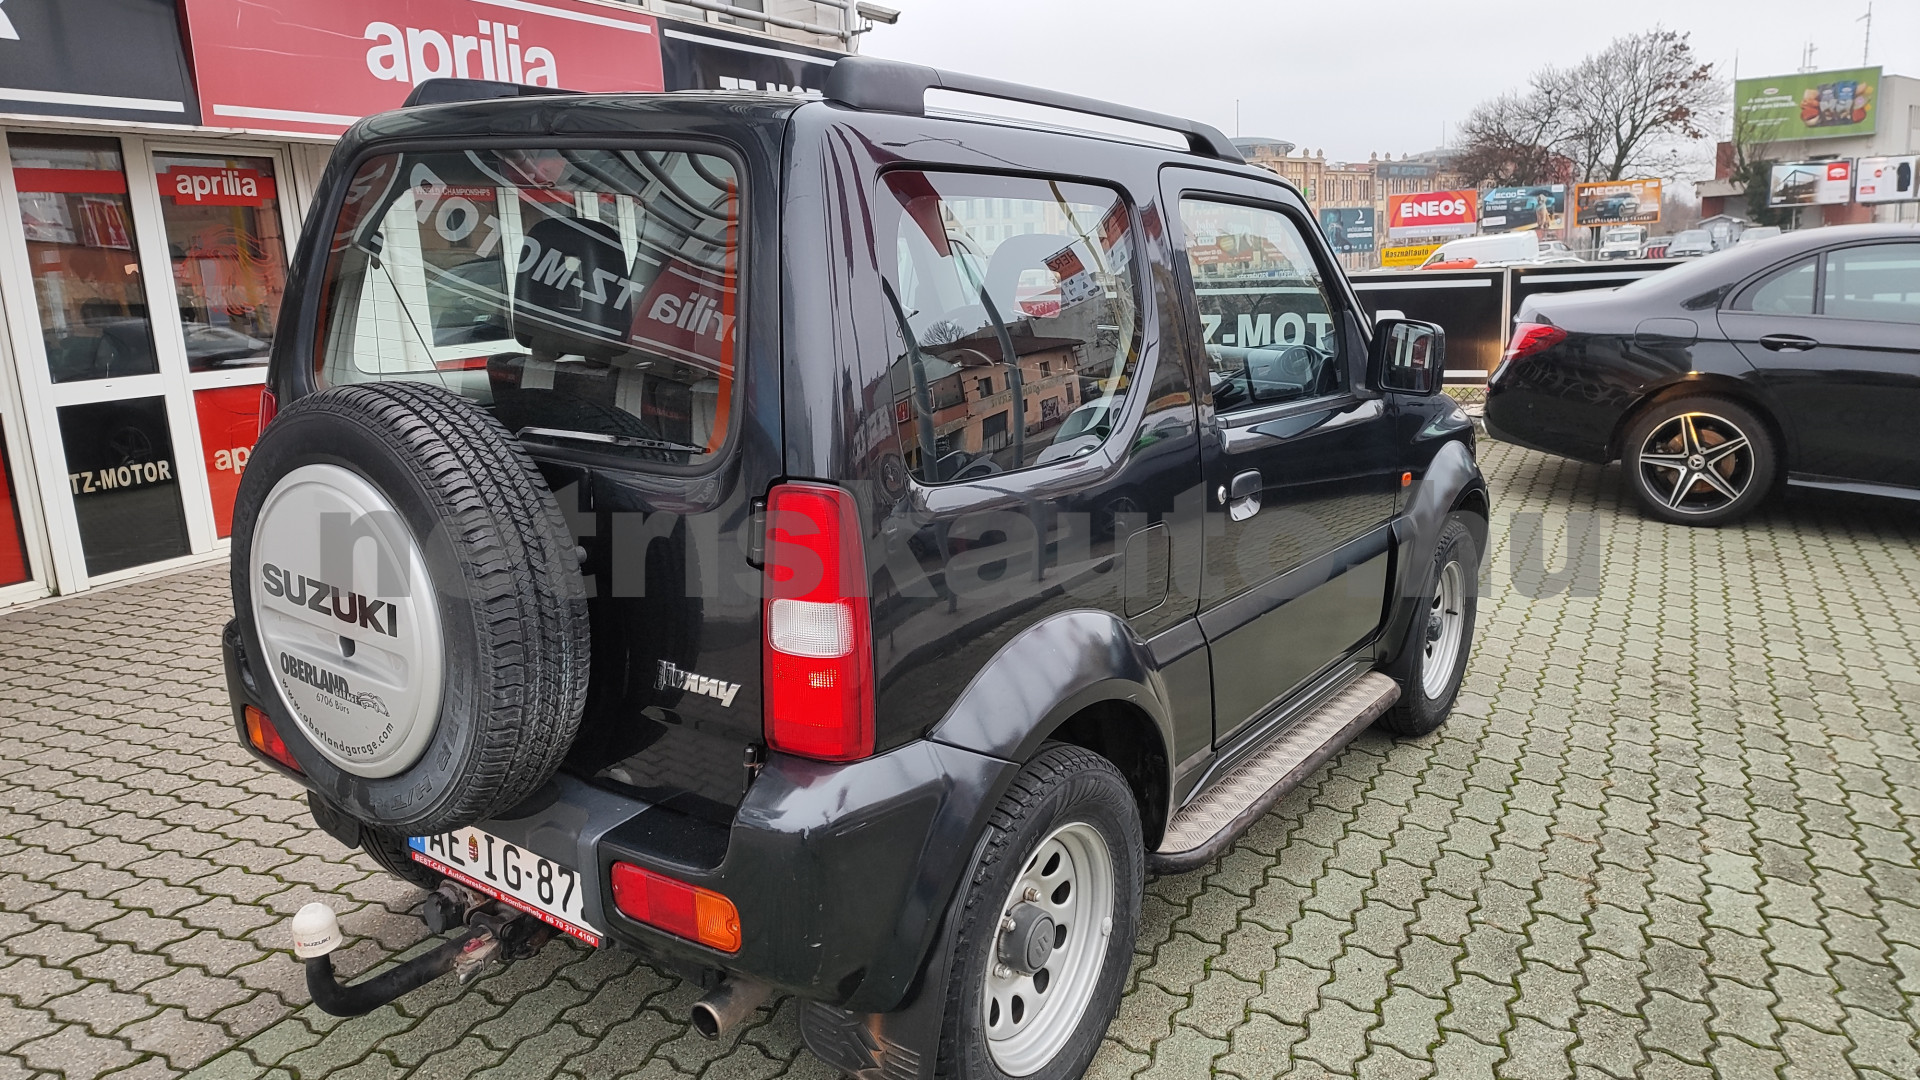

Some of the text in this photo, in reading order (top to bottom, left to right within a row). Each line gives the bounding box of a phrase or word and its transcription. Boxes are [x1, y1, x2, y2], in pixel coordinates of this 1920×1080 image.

[364, 20, 559, 88] aprilia
[176, 169, 258, 201] aprilia
[1401, 199, 1466, 218] ENEOS
[69, 460, 172, 494] TZ-MOTOR
[262, 562, 398, 638] SUZUKI
[280, 651, 349, 694] OBERLAND
[316, 692, 333, 707] 6706
[282, 678, 394, 756] www.oberlandgarage.com
[414, 854, 447, 875] BEST-CAR
[447, 869, 498, 898] Autókereskedés
[500, 893, 543, 920] Szombathely
[555, 919, 563, 928] 70
[565, 924, 577, 934] 317
[578, 931, 595, 944] 4100
[484, 834, 587, 922] IG-87
